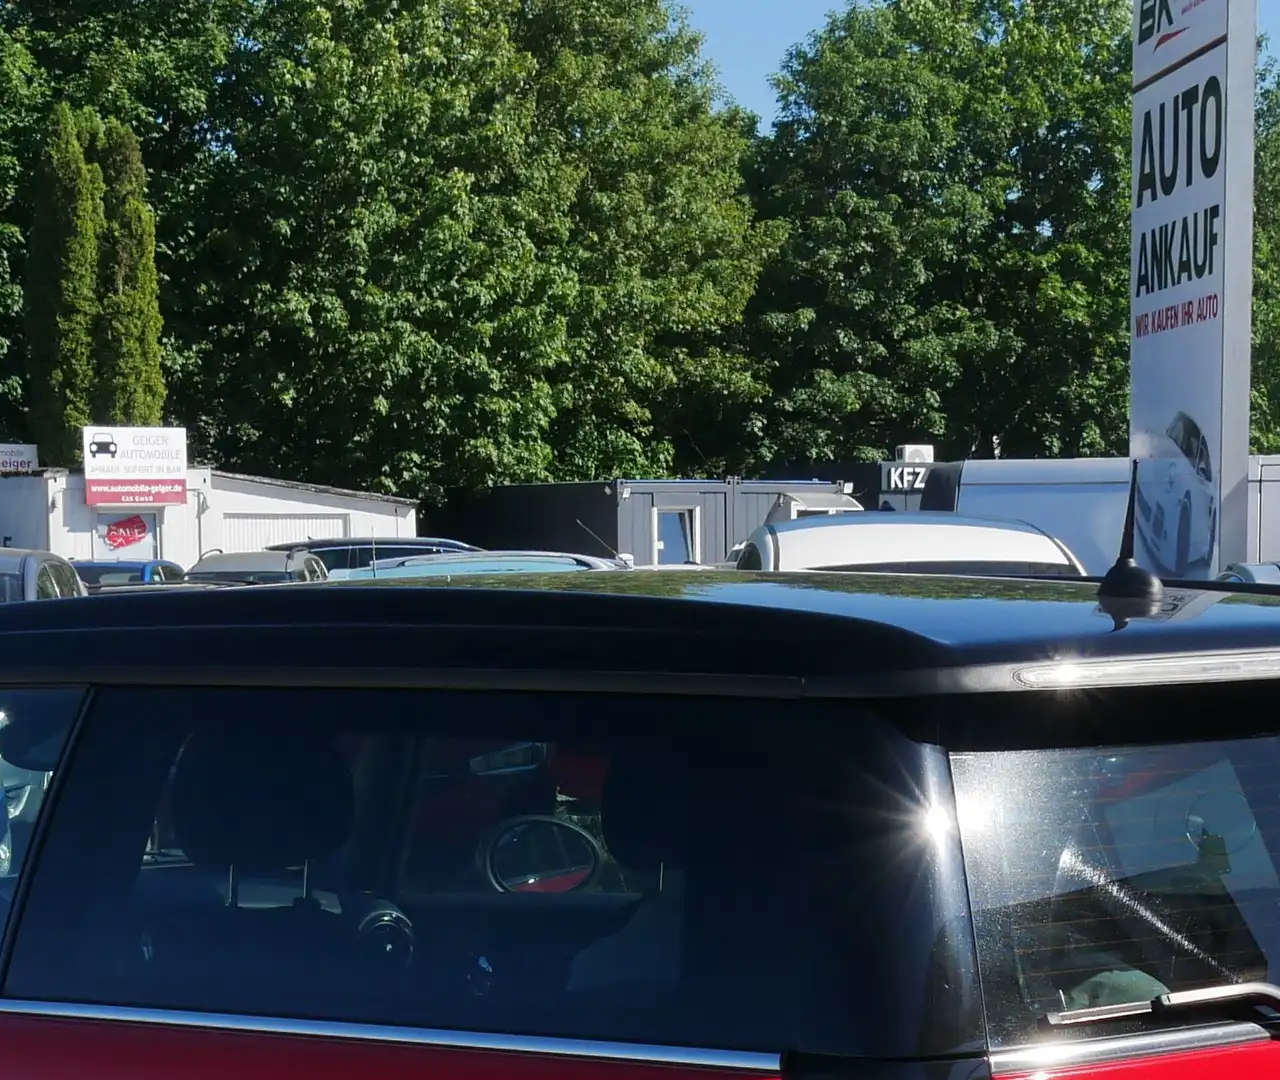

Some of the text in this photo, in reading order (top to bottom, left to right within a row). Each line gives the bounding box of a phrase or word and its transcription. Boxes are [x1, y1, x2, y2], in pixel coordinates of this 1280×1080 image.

[1136, 75, 1223, 209] AUTO
[1136, 203, 1220, 298] ANKAUF
[1135, 293, 1219, 338] WIR KAUFEN IHR AUTO
[132, 435, 169, 446] GEIGER
[120, 449, 182, 460] AUTOMOBILE
[90, 483, 183, 494] www.automobile-geiger.de
[889, 466, 927, 489] KFZ
